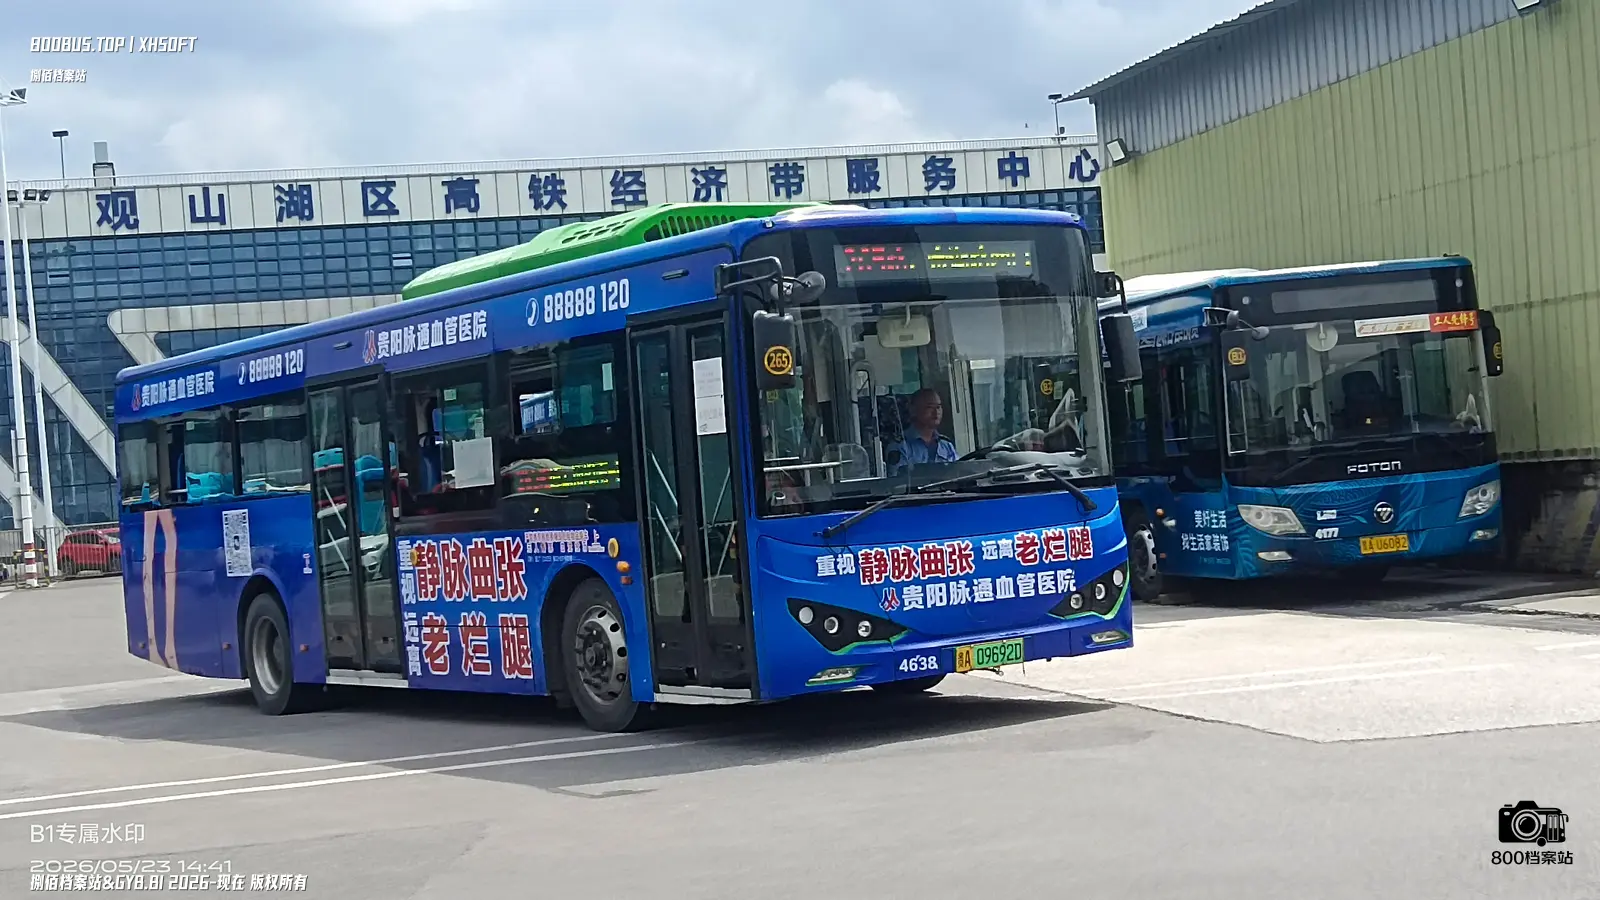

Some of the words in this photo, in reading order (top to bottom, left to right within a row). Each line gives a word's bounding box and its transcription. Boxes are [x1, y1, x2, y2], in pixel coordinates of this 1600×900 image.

[96, 148, 1100, 231] 观山湖区高铁经济带服务中心
[377, 310, 487, 359] 贵阳脉通血管医院
[543, 285, 596, 323] 88888
[600, 278, 630, 313] 120
[141, 370, 215, 407] 贵阳脉通血管医院
[249, 354, 283, 383] 88888
[285, 349, 304, 375] 120
[769, 353, 788, 368] 265
[1347, 461, 1401, 474] FOTON
[1194, 510, 1227, 528] 美好生活
[398, 540, 416, 604] 重视
[415, 537, 528, 602] 静脉曲张
[816, 553, 855, 577] 重视
[858, 540, 975, 585] 静脉曲张
[981, 538, 1013, 561] 远离
[1014, 526, 1094, 566] 老烂腿
[902, 569, 1077, 611] 贵阳脉通血管医院
[421, 611, 533, 679] 老烂腿
[976, 643, 1022, 665] 09692D
